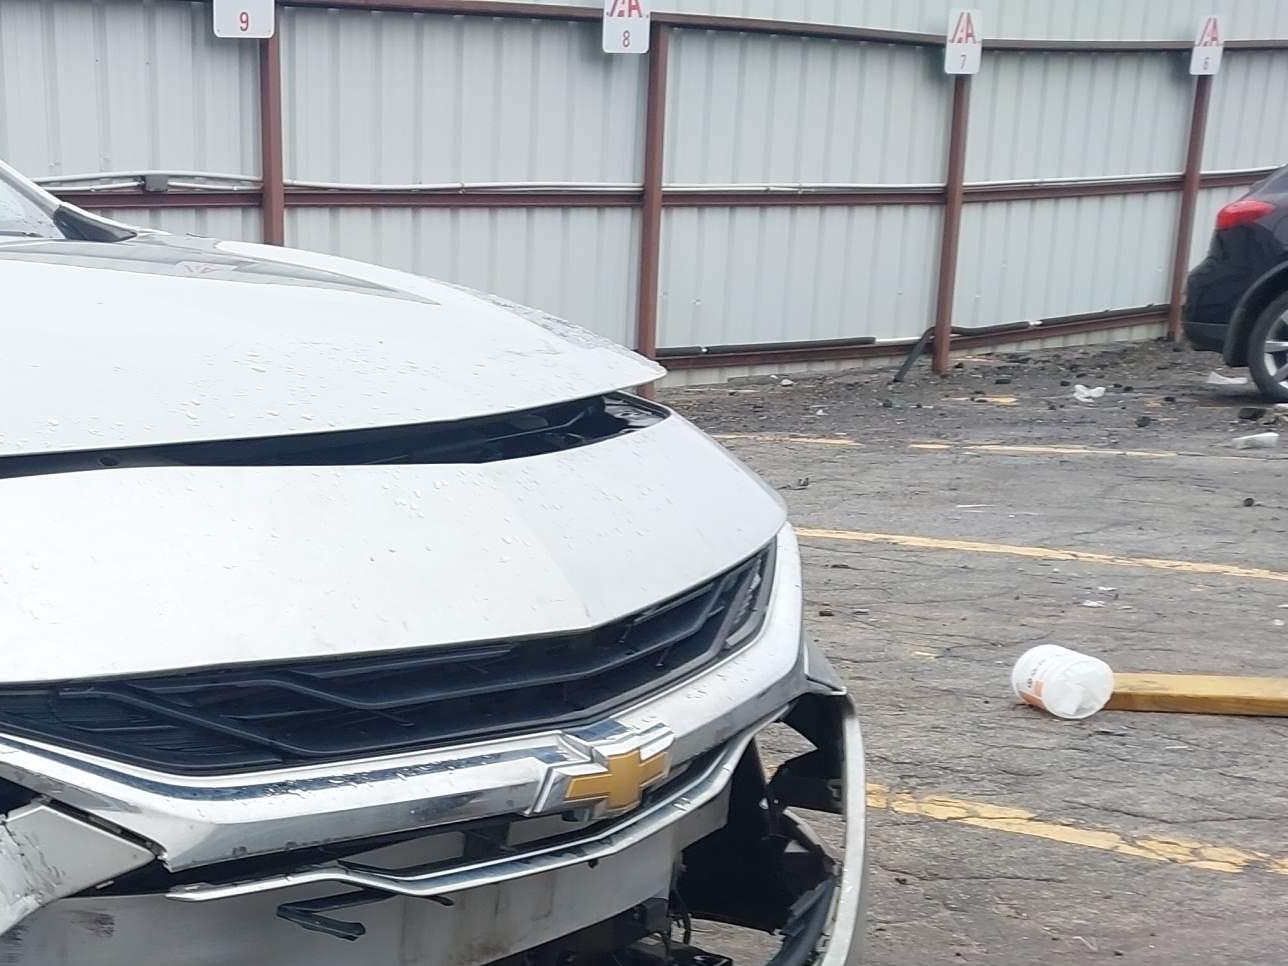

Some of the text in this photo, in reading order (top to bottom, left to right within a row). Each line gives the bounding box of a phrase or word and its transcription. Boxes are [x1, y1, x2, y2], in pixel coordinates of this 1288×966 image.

[239, 11, 249, 32] 9
[622, 30, 631, 48] 8
[960, 54, 967, 70] 7
